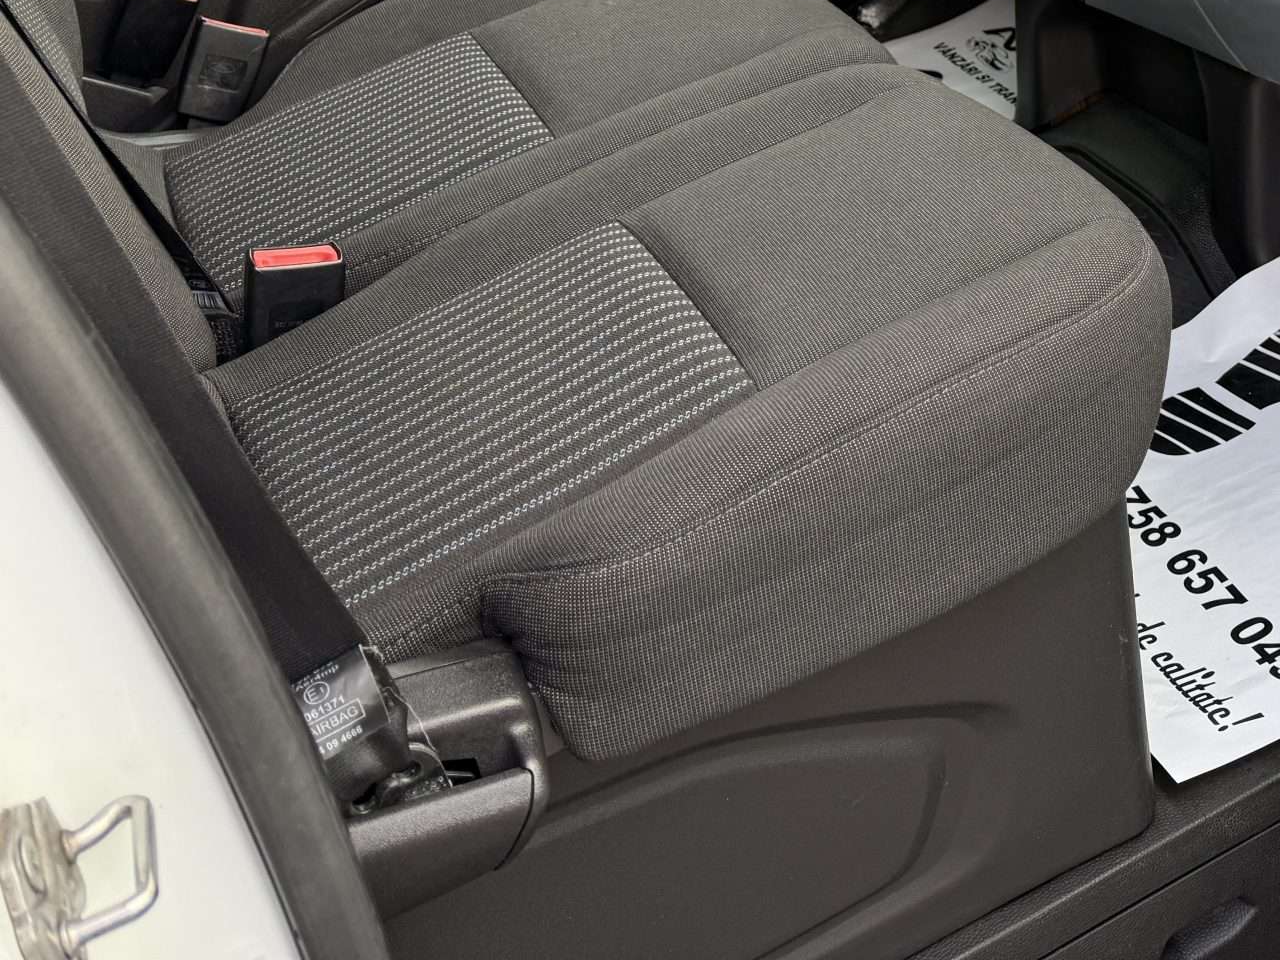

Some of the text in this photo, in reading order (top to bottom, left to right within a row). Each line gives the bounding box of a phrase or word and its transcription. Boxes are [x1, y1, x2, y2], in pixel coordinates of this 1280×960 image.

[1166, 549, 1249, 610] 657
[311, 706, 359, 736] AIRBAG
[1151, 651, 1265, 732] calitate!
